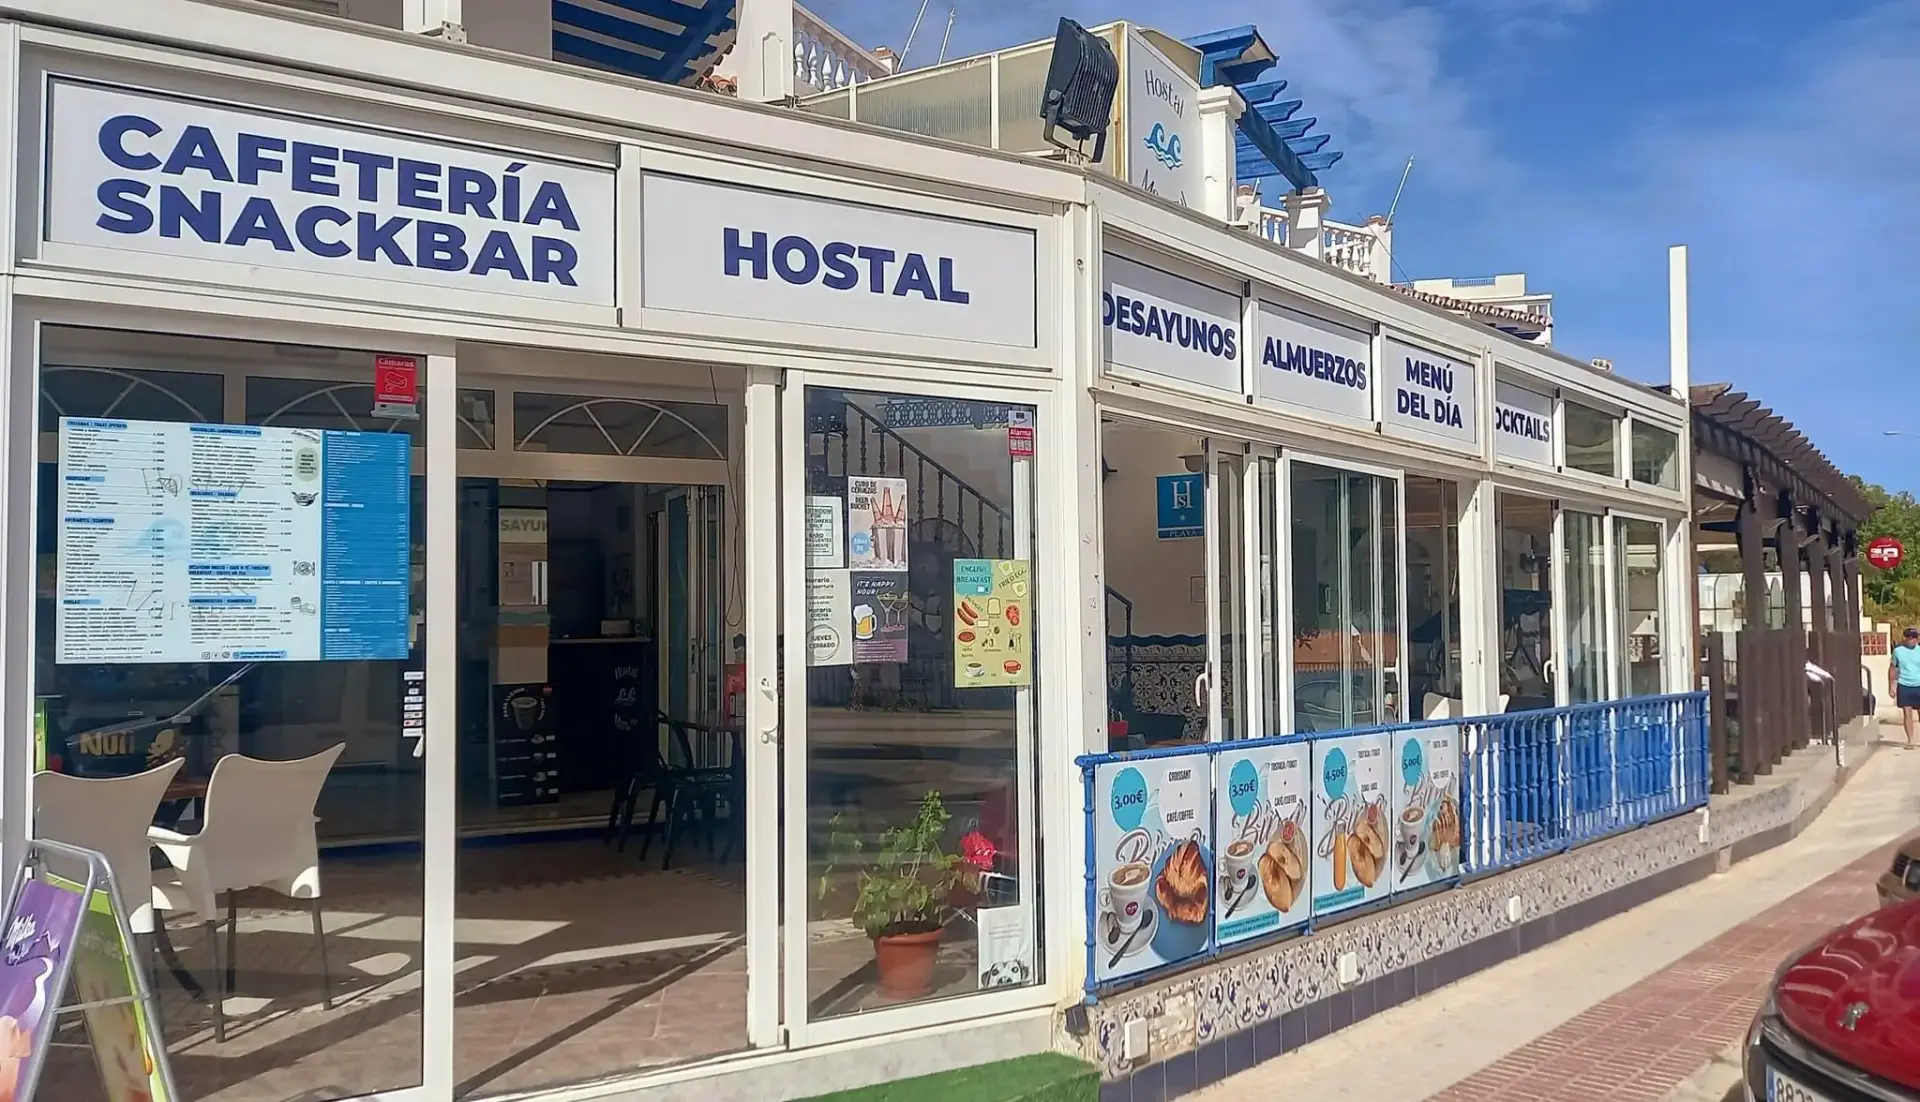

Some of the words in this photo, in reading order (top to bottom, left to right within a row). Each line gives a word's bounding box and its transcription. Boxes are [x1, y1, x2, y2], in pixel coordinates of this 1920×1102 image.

[1145, 70, 1185, 119] Hostal
[98, 114, 580, 232] CAFETERÍA
[96, 178, 579, 287] SNACKBAR
[723, 227, 969, 304] HOSTAL
[1103, 291, 1236, 360] DESAYUNOS
[378, 357, 415, 368] Cámaras
[1263, 336, 1367, 391] ALMUERZOS
[1405, 357, 1453, 393] MENÚ
[1397, 389, 1430, 421] DEL
[1434, 394, 1463, 429] DÍA
[1169, 529, 1198, 538] PLAYA
[871, 580, 895, 588] HAPPY
[960, 565, 987, 573] ENGLISH
[998, 576, 1015, 589] FRIED
[1015, 567, 1027, 578] EGG
[1168, 769, 1192, 782] CROISSANT
